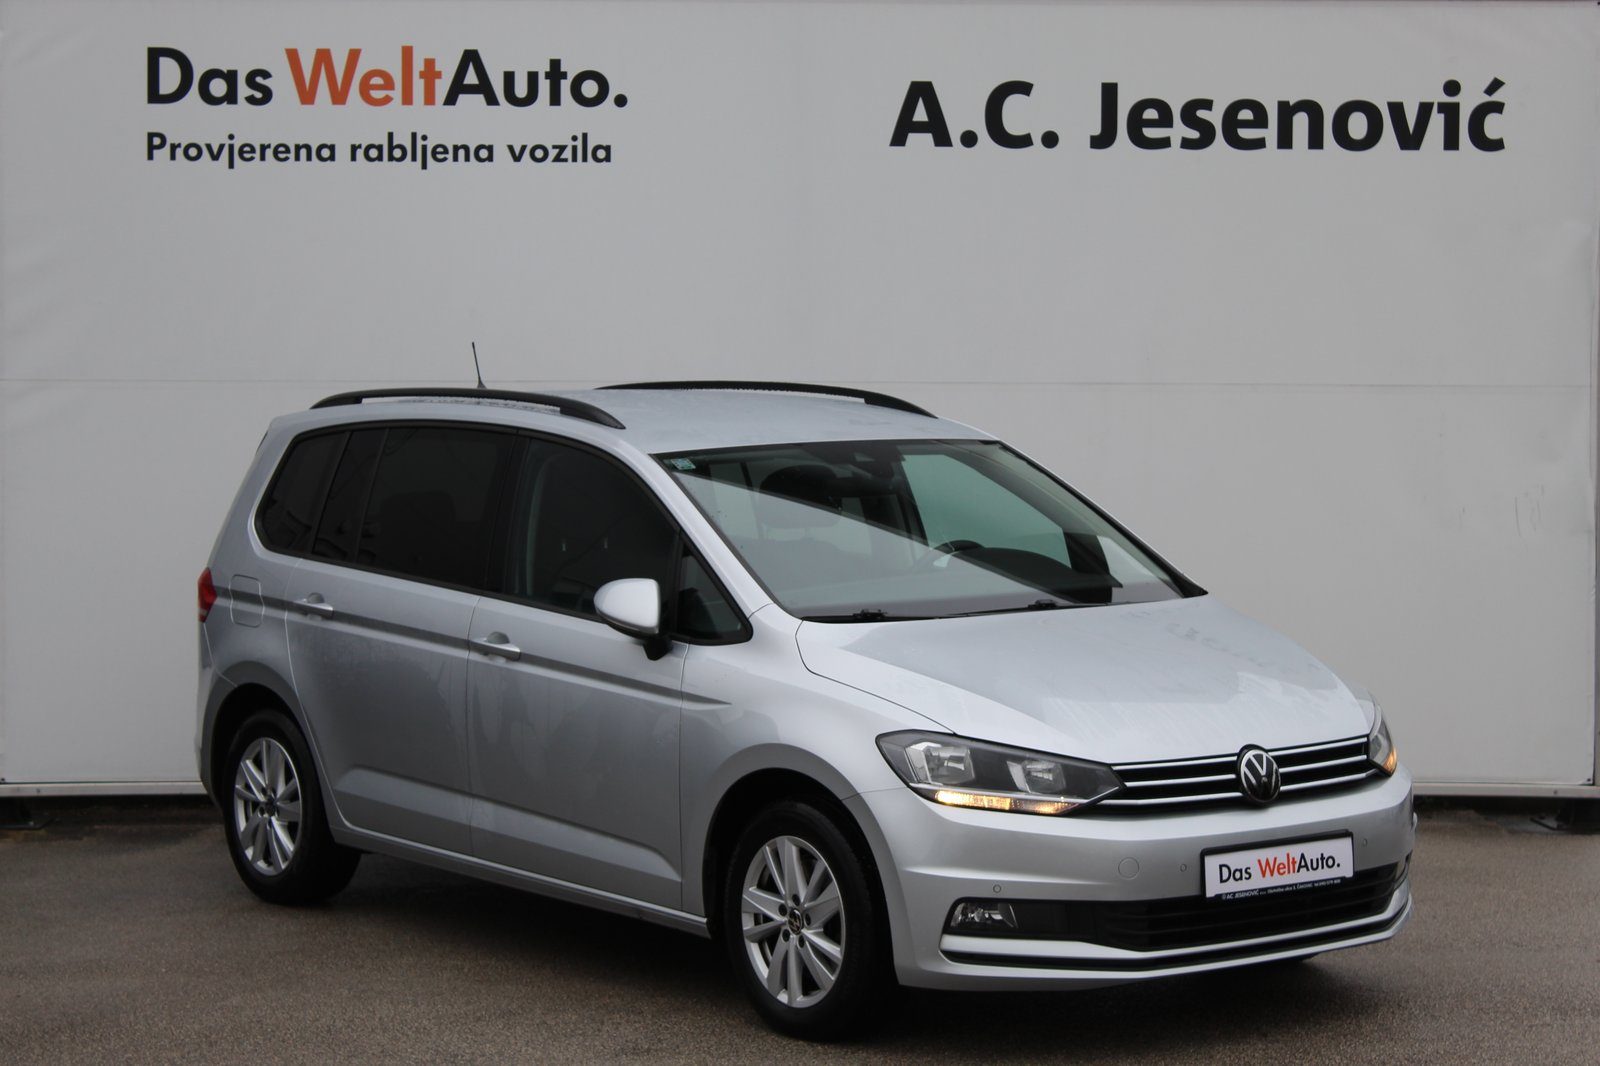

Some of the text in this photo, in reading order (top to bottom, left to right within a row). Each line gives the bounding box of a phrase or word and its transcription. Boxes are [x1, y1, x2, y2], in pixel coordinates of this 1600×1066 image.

[146, 45, 628, 109] Das WeltAuto.
[888, 76, 1506, 153] A.C. Jesenović
[146, 131, 612, 171] Provjerena rabljena vozila
[1218, 852, 1341, 884] Das WeltAuto.
